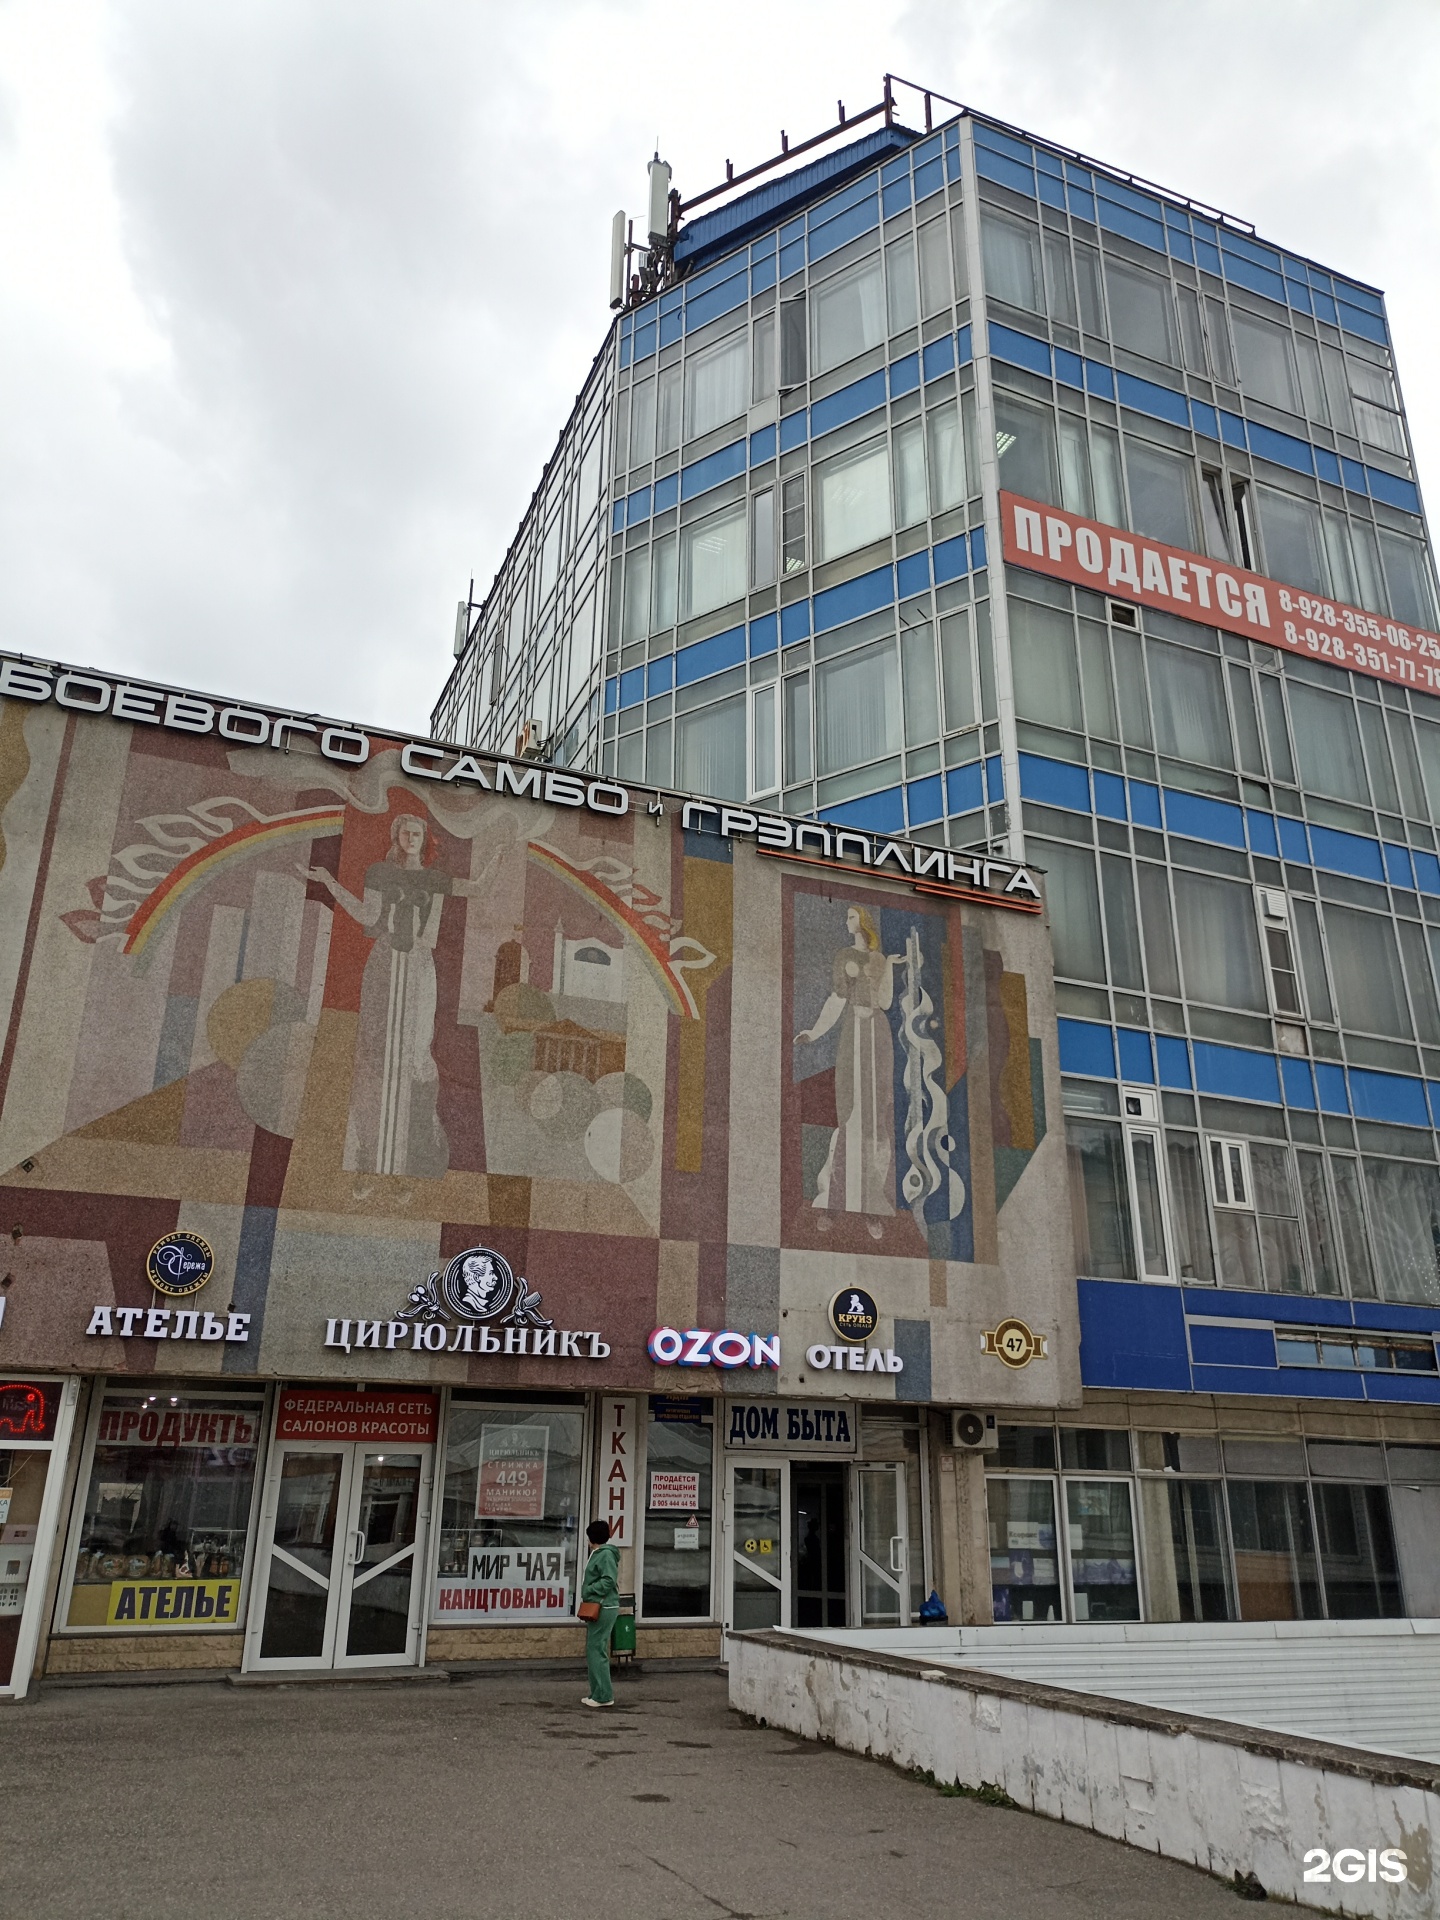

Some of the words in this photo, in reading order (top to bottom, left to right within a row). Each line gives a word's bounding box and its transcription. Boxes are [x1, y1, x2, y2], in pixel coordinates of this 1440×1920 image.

[1013, 505, 1271, 628] ПРОДАЕТСЯ
[1278, 589, 1440, 660] 8-928-355-06-25
[0, 661, 370, 763] БОЕВОГО
[401, 744, 629, 815] САМБО
[682, 801, 1041, 898] ГРЭППЛИНГА
[86, 1306, 251, 1342] АТЕЛЬЕ
[838, 1313, 873, 1324] КРУИЗ
[323, 1318, 611, 1359] ЦИРЮЛЬНИКЪ
[649, 1327, 780, 1369] OZON
[1006, 1337, 1023, 1352] 47
[806, 1344, 904, 1374] ОТЕЛЬ
[284, 1399, 395, 1415] ФЕДЕРАЛЬНАЯ
[398, 1402, 433, 1415] СЕТЬ
[282, 1419, 357, 1433] САЛОНОВ
[361, 1421, 430, 1435] КРАСОТЫ
[730, 1406, 779, 1445] ДОМ
[787, 1408, 851, 1443] БЫТА
[487, 1461, 538, 1469] СТРИЖКА
[607, 1404, 627, 1540] ТКАНИ
[486, 1488, 537, 1497] МАНИКЮР
[652, 1484, 697, 1492] ПОМЕЩЕНИЕ
[471, 1553, 510, 1580] МИР
[516, 1552, 561, 1581] ЧАЯ
[114, 1585, 232, 1620] АТЕЛЬЕ
[438, 1587, 565, 1613] КАНЦТОВАРЫ
